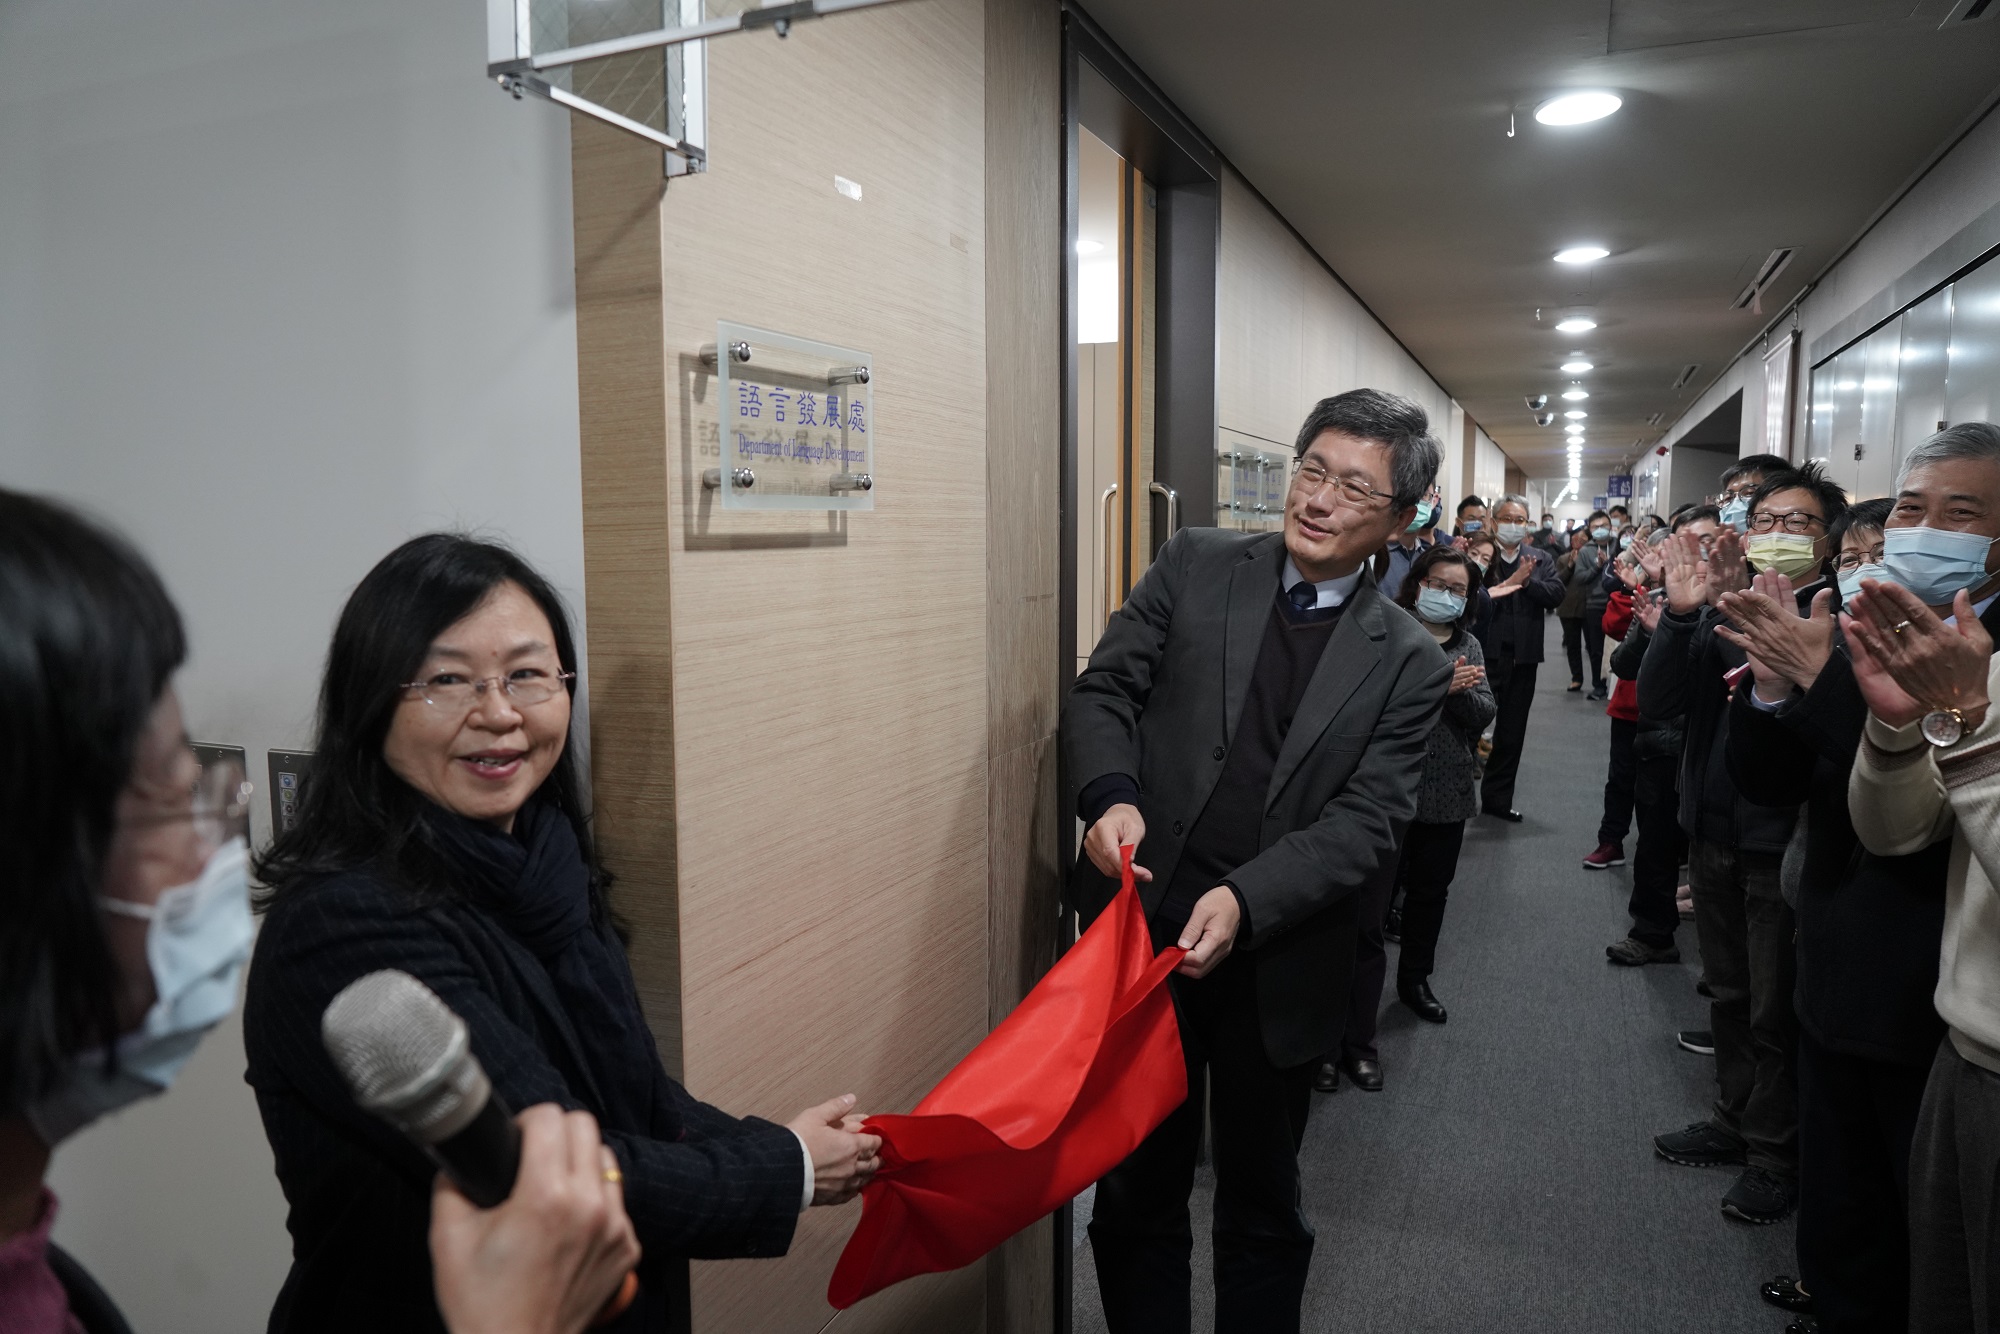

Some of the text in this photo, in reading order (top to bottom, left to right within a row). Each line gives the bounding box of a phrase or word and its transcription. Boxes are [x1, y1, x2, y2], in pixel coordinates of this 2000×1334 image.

[738, 381, 866, 434] 語言發展處
[738, 433, 865, 467] Department of Language Development
